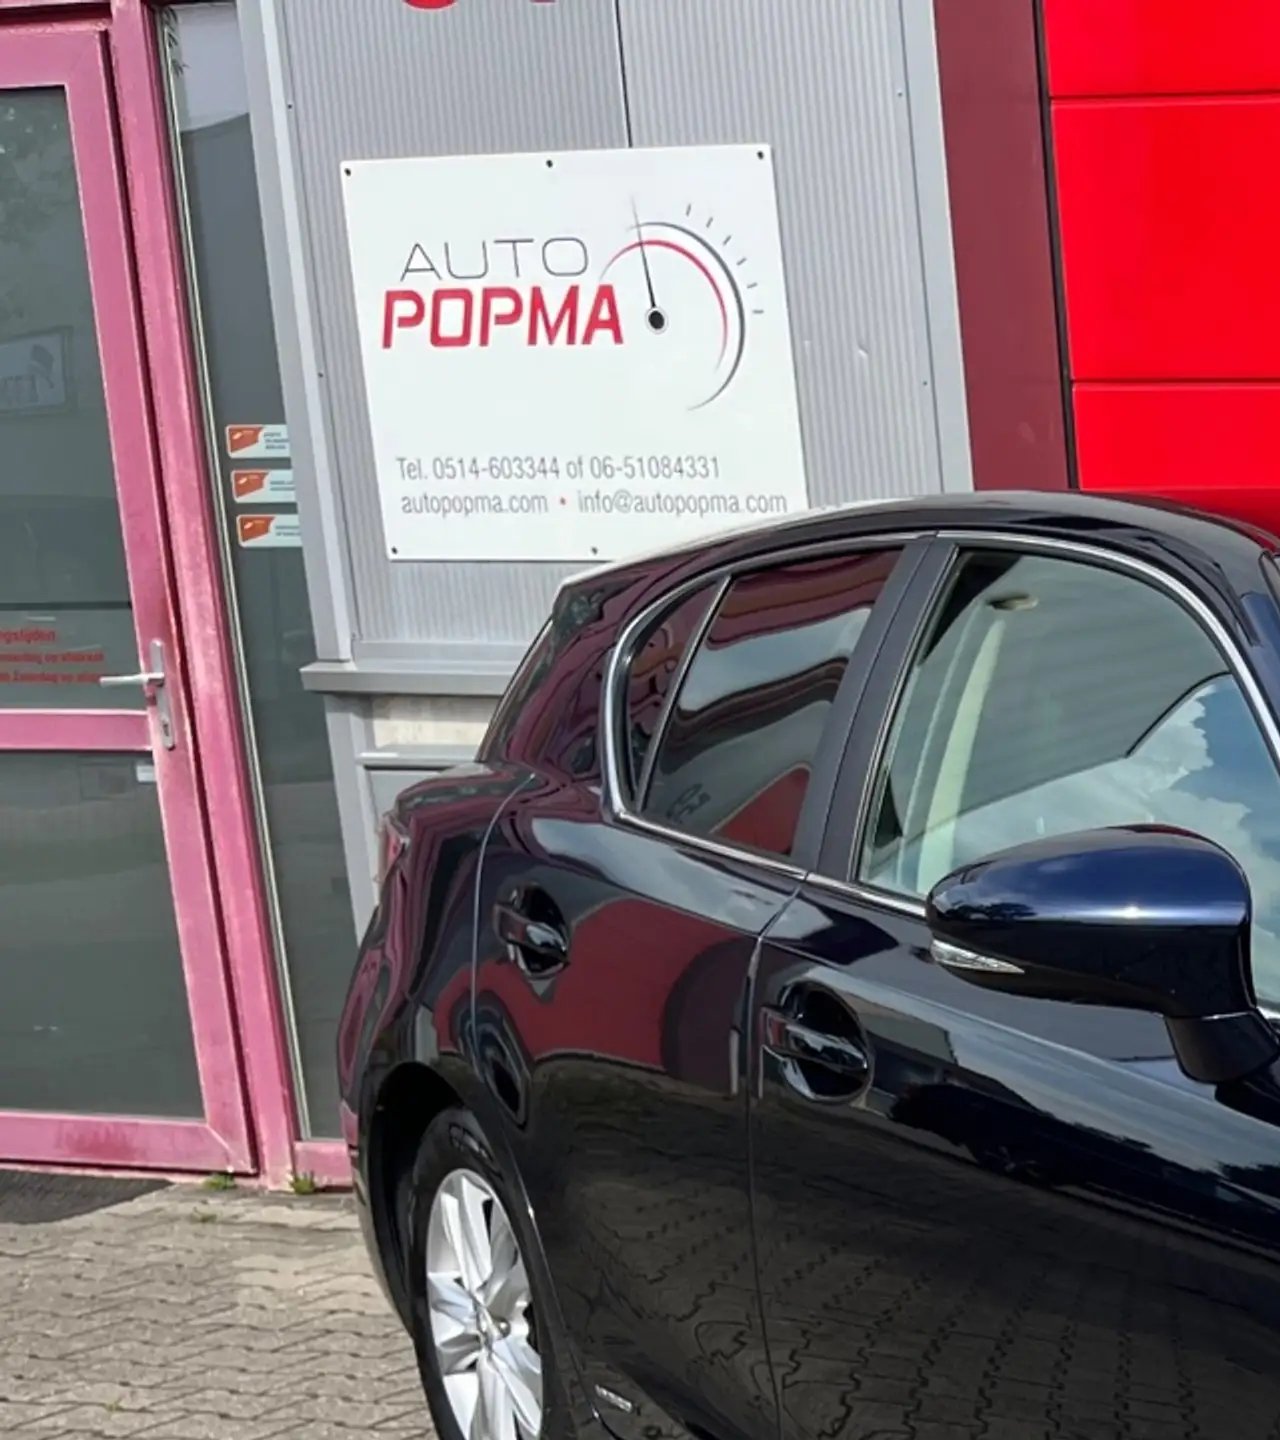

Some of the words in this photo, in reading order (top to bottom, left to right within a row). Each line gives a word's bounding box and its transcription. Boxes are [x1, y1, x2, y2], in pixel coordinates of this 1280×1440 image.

[400, 236, 589, 282] AUTO
[382, 284, 624, 349] POPMA
[396, 456, 429, 481] Tel.
[431, 455, 561, 480] 0514-603344
[566, 454, 585, 480] of
[589, 454, 720, 480] 06-51084331
[401, 490, 549, 519] autopopma.com
[577, 488, 789, 519] info@autopopma.com
